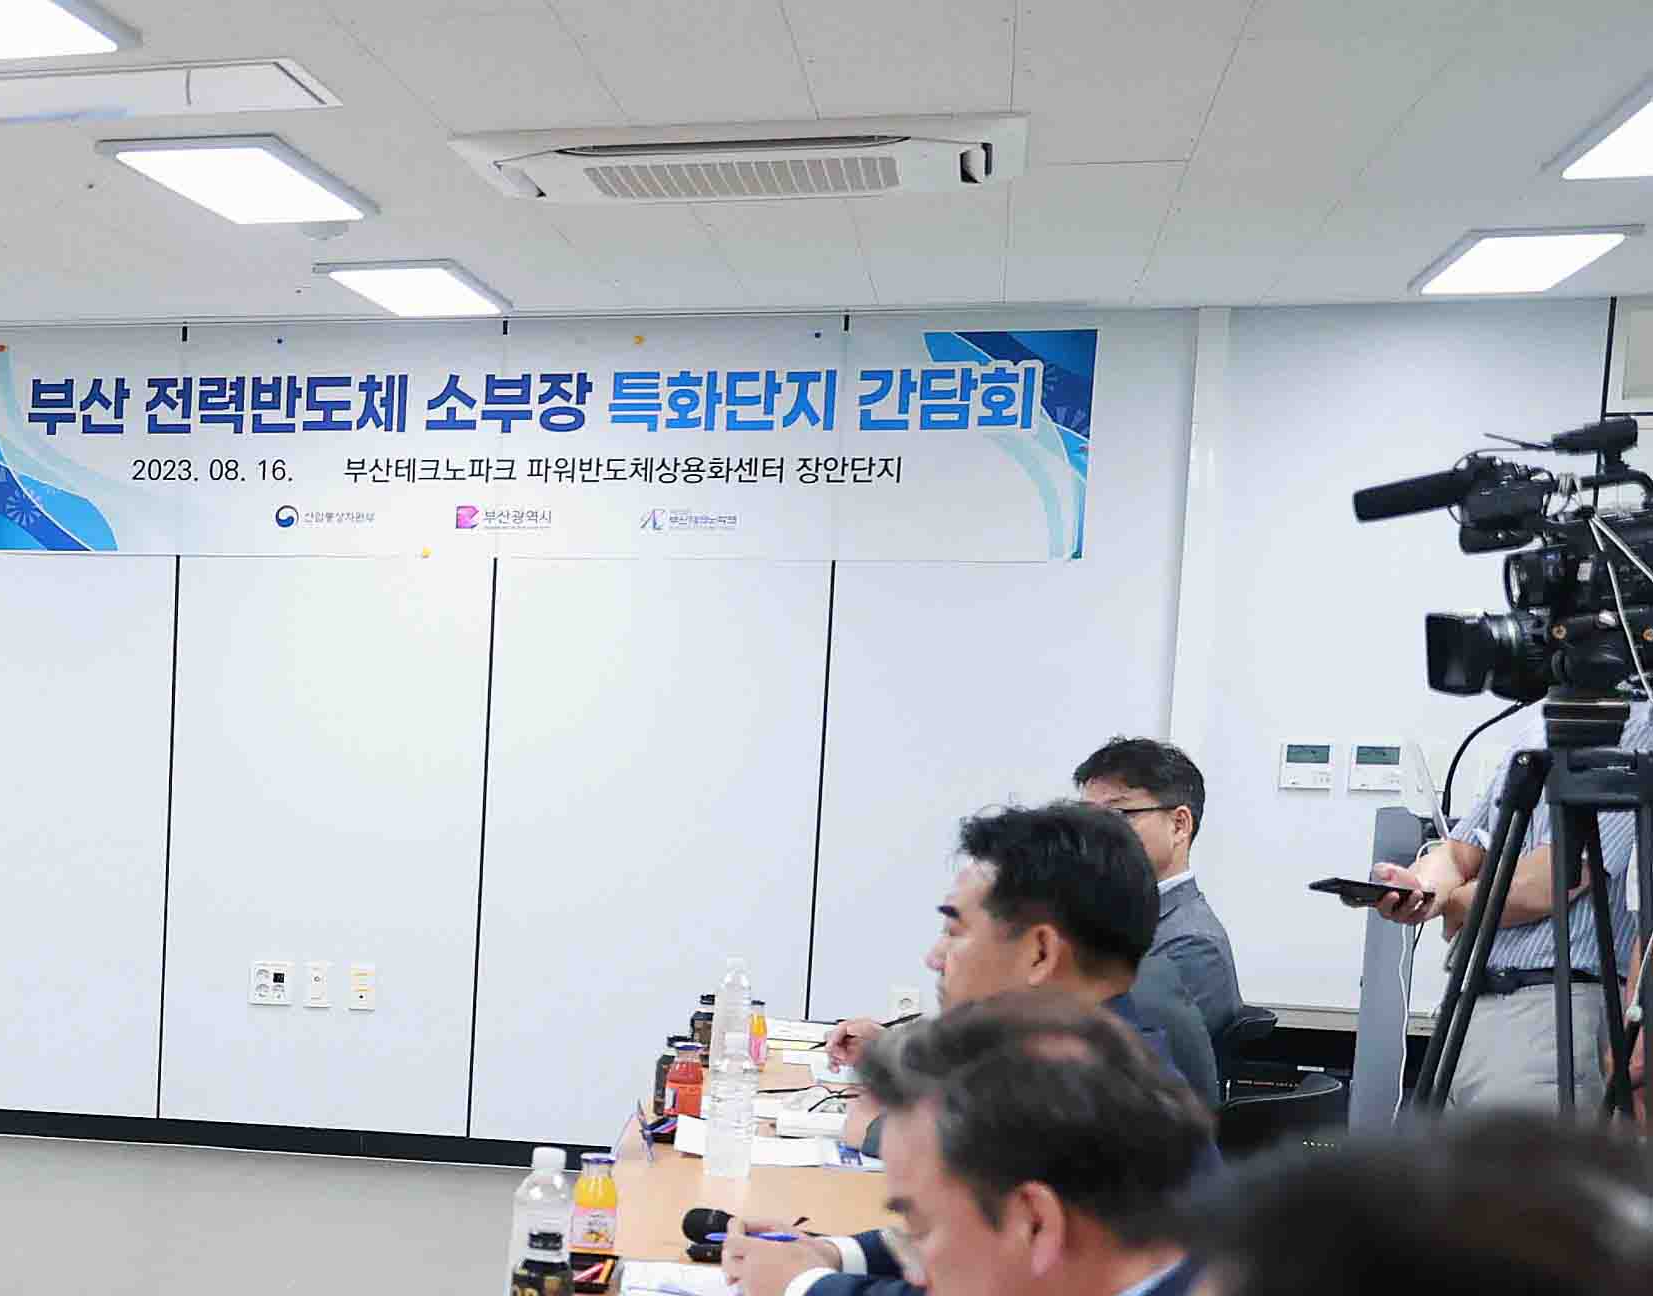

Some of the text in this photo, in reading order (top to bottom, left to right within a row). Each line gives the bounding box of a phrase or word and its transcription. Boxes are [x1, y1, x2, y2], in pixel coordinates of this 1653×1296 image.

[27, 365, 1036, 436] 부산 전력반도체 소부장 특화단지 간담회
[131, 455, 903, 484] 2023. 08. 16. 부산테크노파크 파워반도체상용화센터 장안단지
[483, 509, 552, 525] 부산광역시
